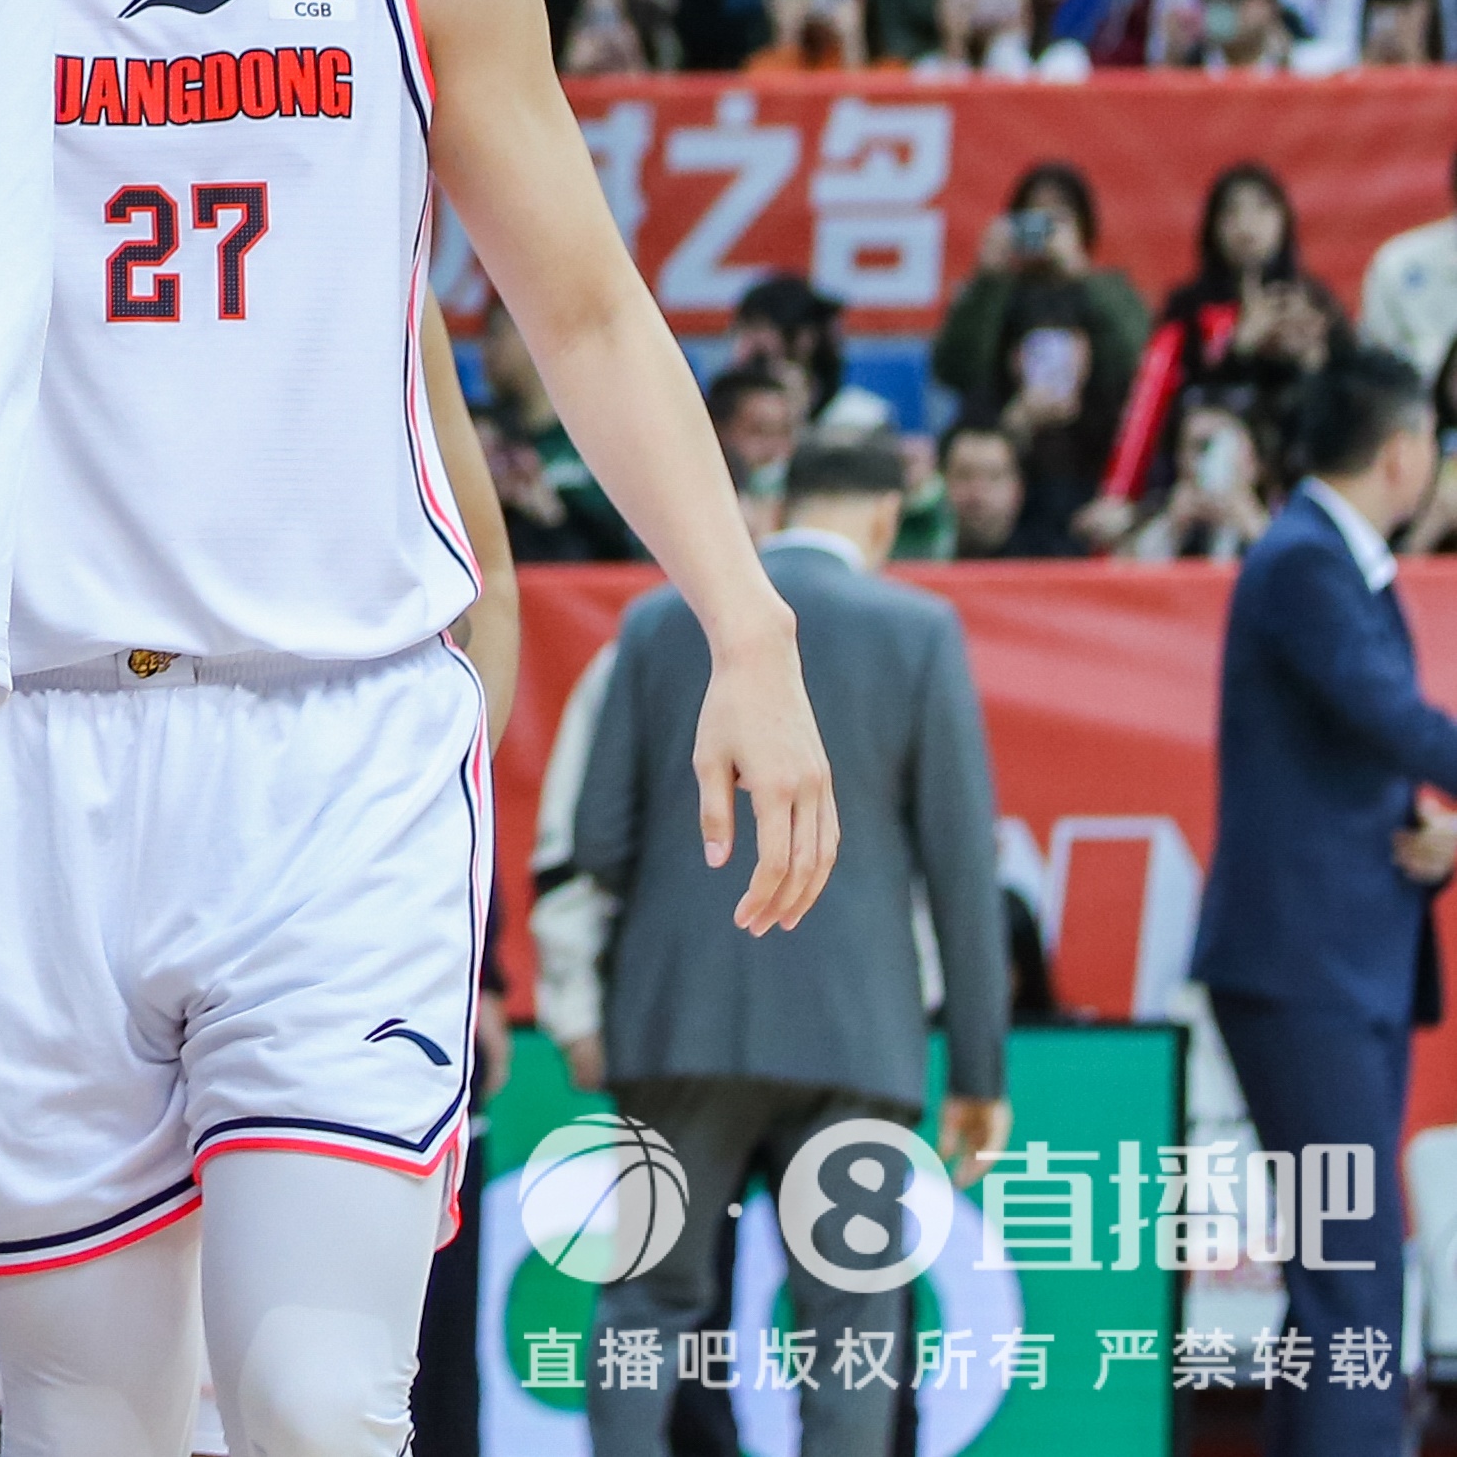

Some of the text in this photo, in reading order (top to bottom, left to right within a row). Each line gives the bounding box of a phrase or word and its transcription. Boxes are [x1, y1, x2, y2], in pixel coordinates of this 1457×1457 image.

[294, 1, 333, 18] CGB
[55, 47, 353, 126] UANGDONG
[103, 182, 270, 323] 27
